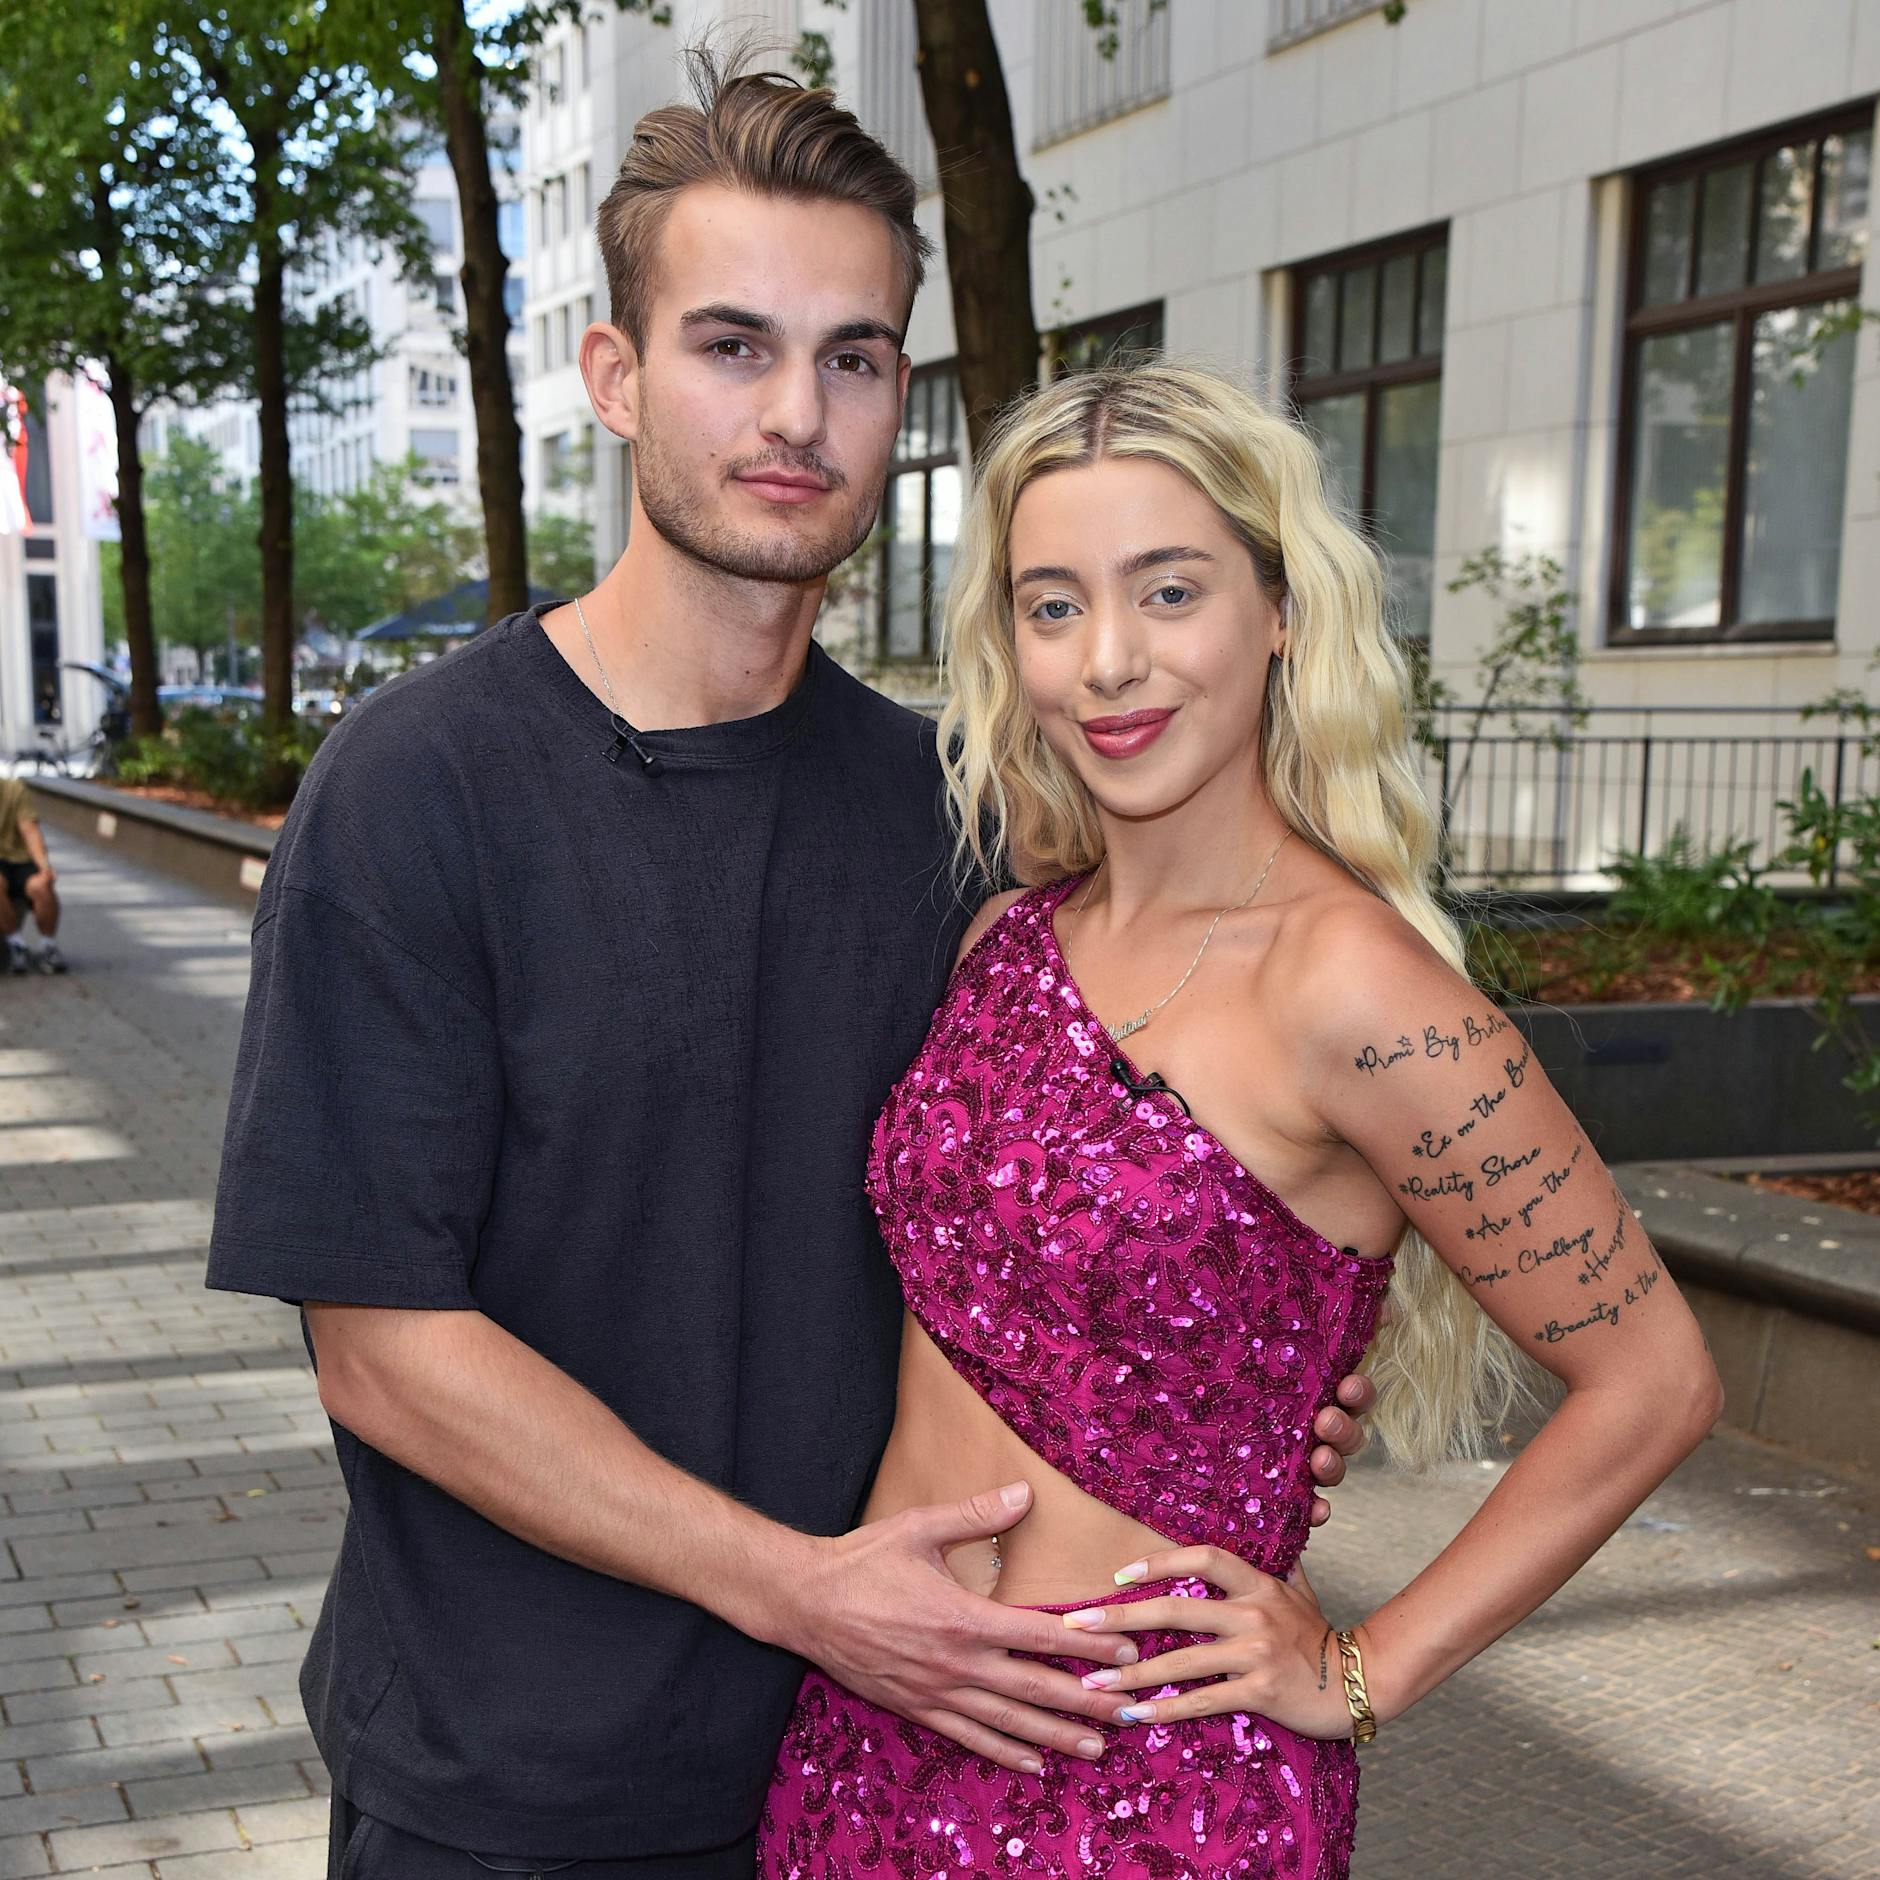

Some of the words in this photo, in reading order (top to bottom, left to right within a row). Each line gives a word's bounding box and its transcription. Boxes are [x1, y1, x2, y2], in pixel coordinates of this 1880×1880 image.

[1423, 1025, 1460, 1061] Big
[1462, 1013, 1513, 1046] Brothe
[1412, 1131, 1452, 1158] #Ex
[1457, 1119, 1475, 1137] on
[1469, 1088, 1506, 1118] the
[1399, 1171, 1474, 1201] #Reality
[1481, 1147, 1541, 1186] Shore
[1465, 1213, 1511, 1240] #Are
[1518, 1195, 1543, 1227] you
[1538, 1167, 1570, 1194] the
[1457, 1263, 1511, 1290] Couple
[1518, 1227, 1594, 1274] Challenge
[1534, 1302, 1619, 1343] #Beauty
[1625, 1288, 1639, 1305] &
[1634, 1270, 1657, 1295] the
